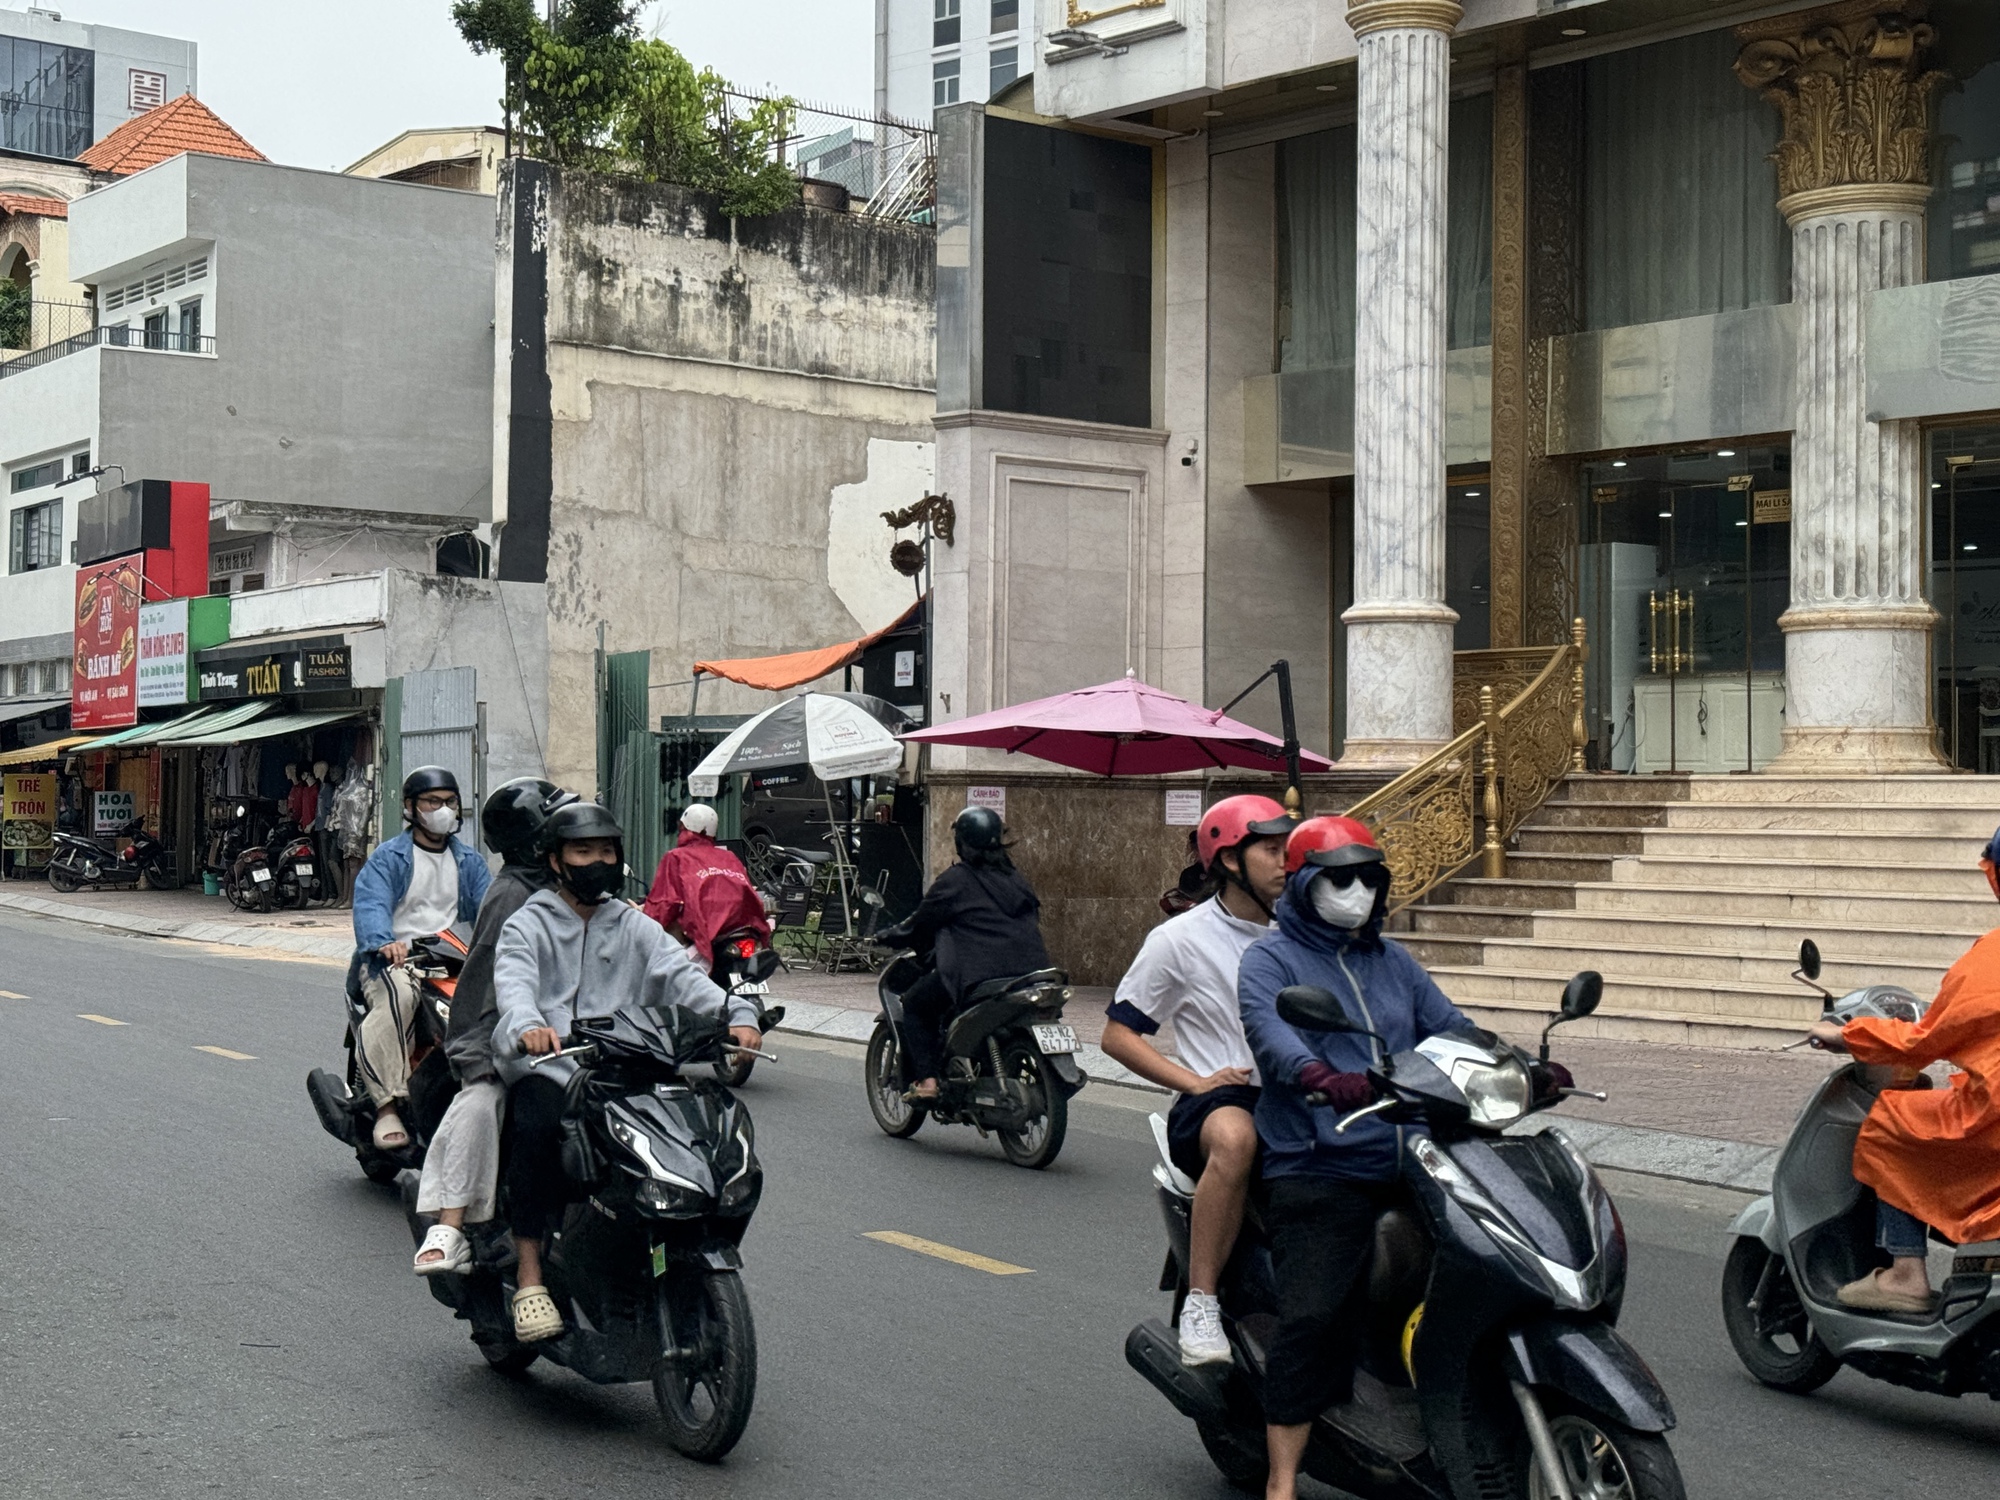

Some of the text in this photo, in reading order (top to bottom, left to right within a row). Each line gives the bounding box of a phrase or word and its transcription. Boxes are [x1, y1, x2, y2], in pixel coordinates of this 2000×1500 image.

[308, 650, 345, 665] TUẤN
[87, 653, 110, 680] BÁNH
[308, 667, 346, 676] FASHION
[217, 671, 238, 689] Trang
[246, 655, 281, 695] TUẤN
[762, 776, 789, 786] COFFEE
[99, 793, 132, 806] HOA
[11, 798, 46, 818] TRỘN
